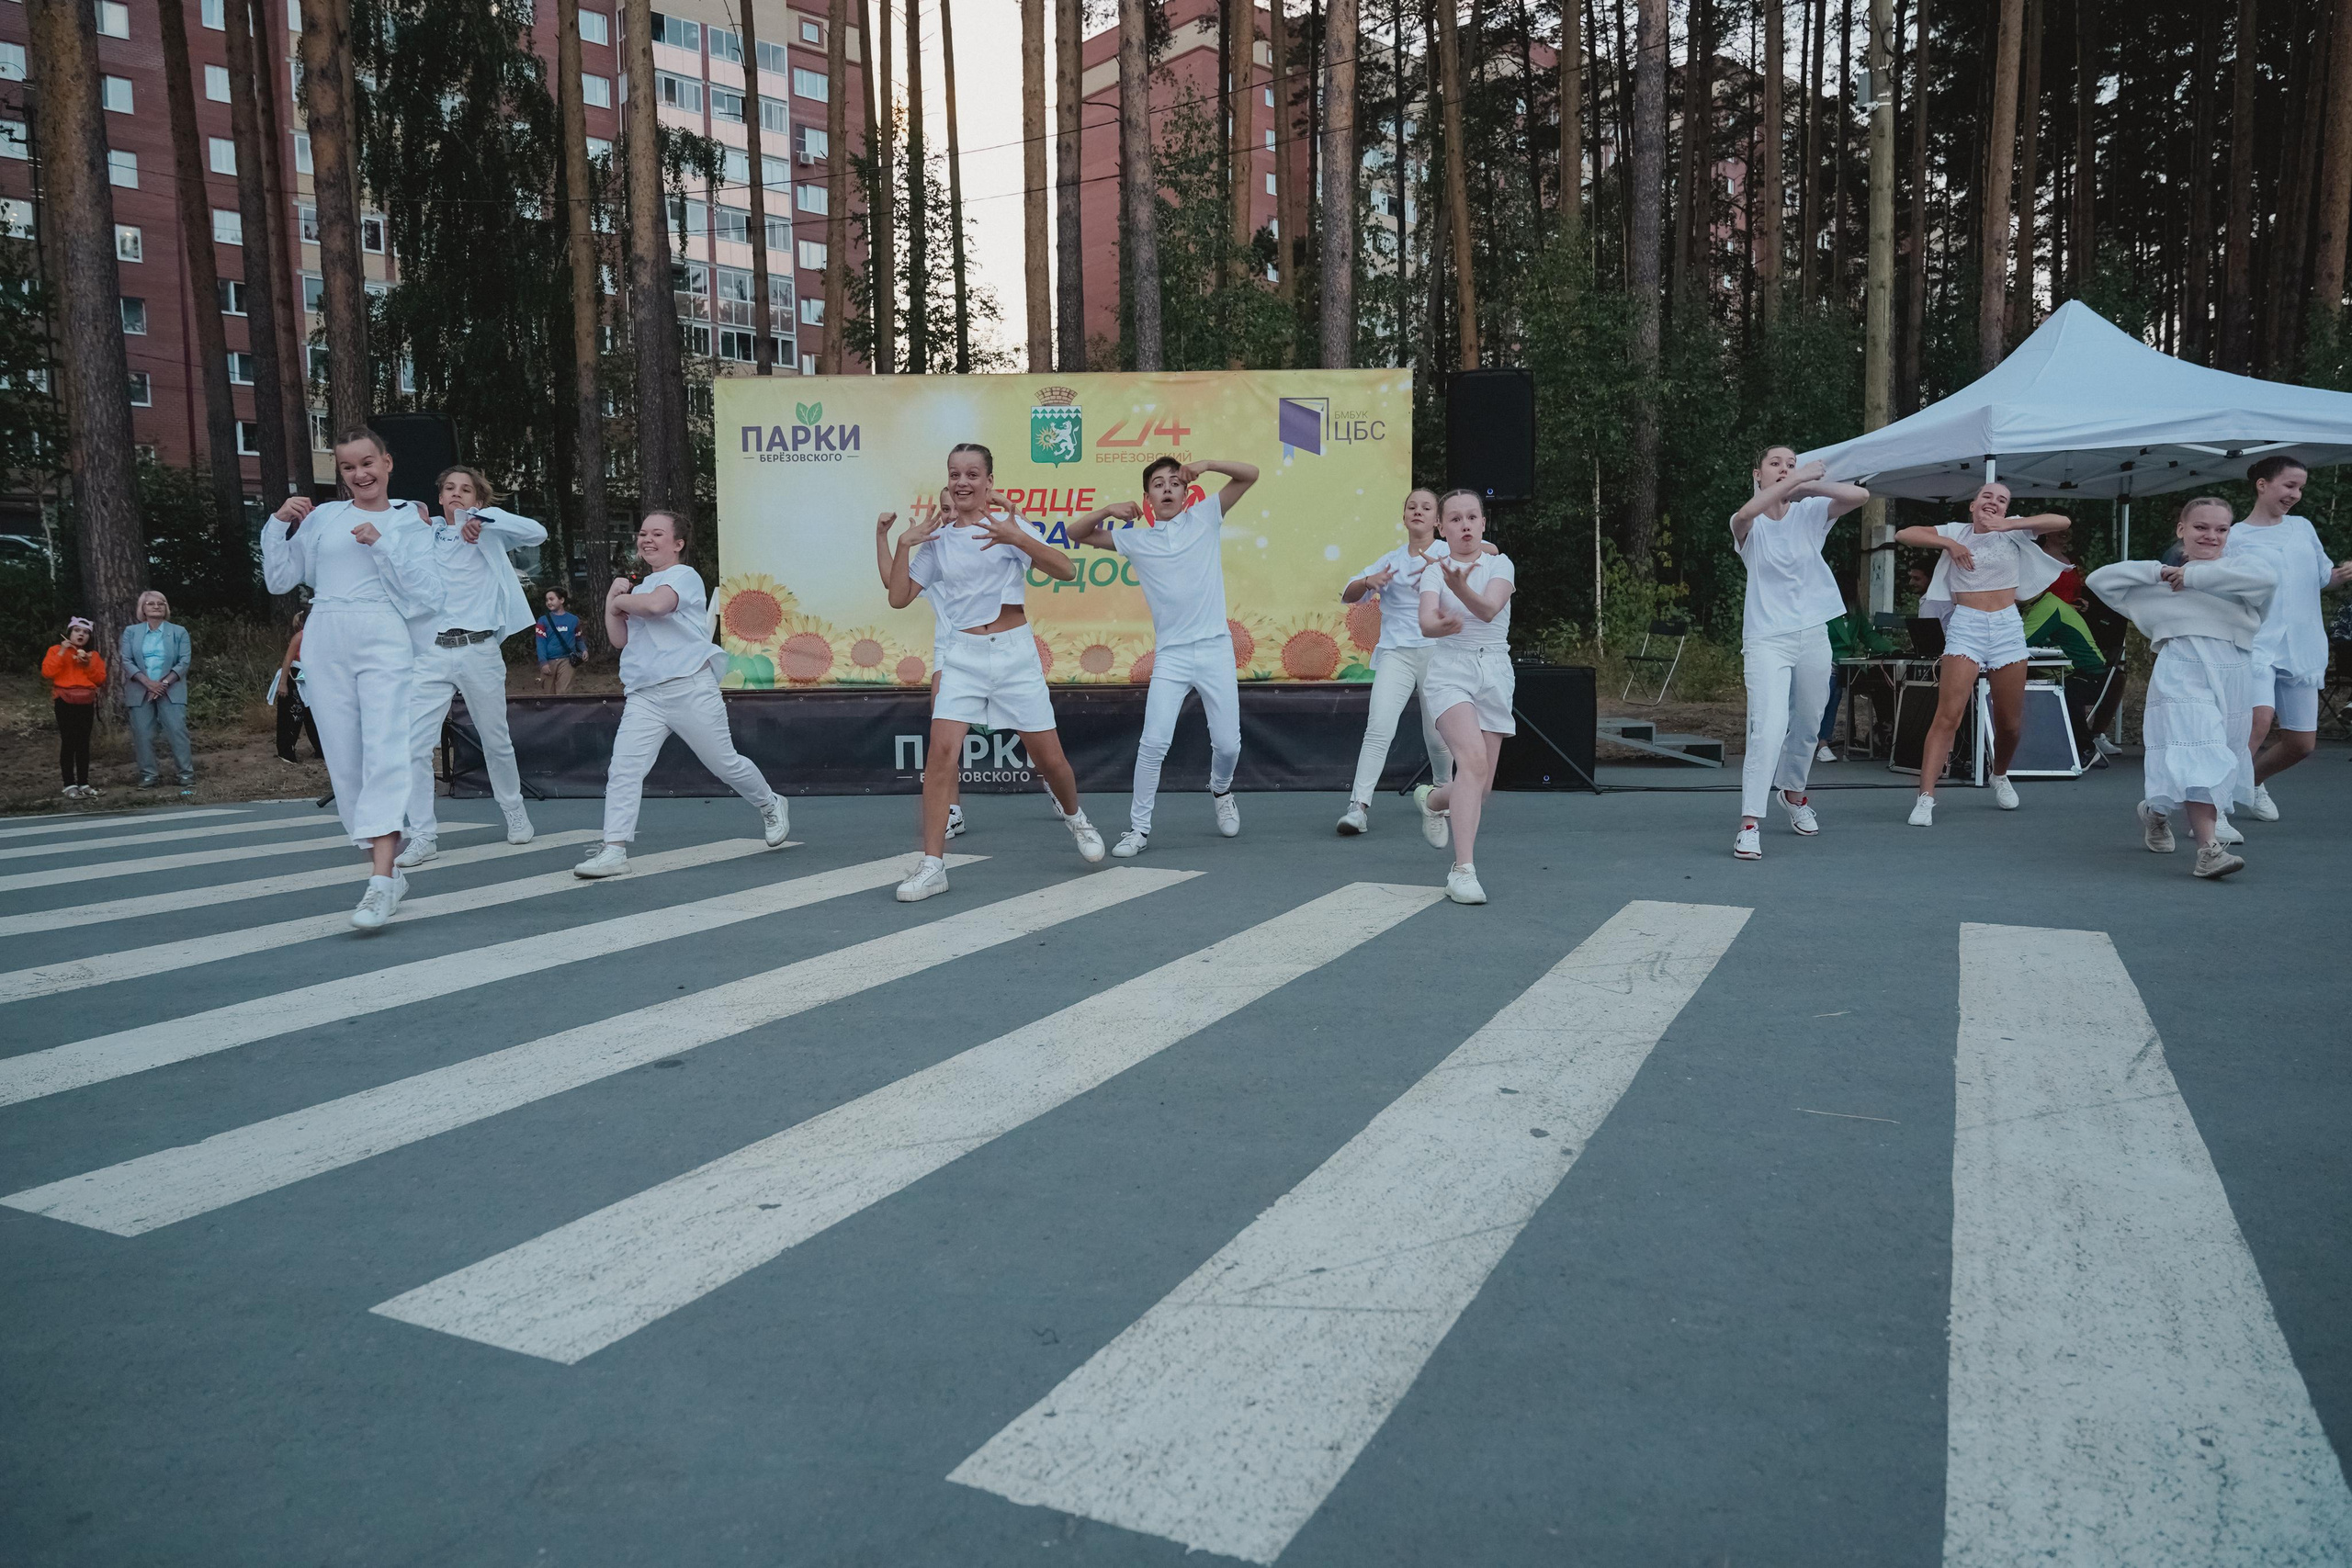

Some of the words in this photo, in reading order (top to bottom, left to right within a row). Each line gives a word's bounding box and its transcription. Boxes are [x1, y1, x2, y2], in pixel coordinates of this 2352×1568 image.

[1334, 411, 1368, 419] БМБУК
[741, 424, 860, 452] ПАРКИ
[1335, 421, 1385, 445] ЦБС
[760, 452, 842, 463] БЕРЁЗОВСКОГО
